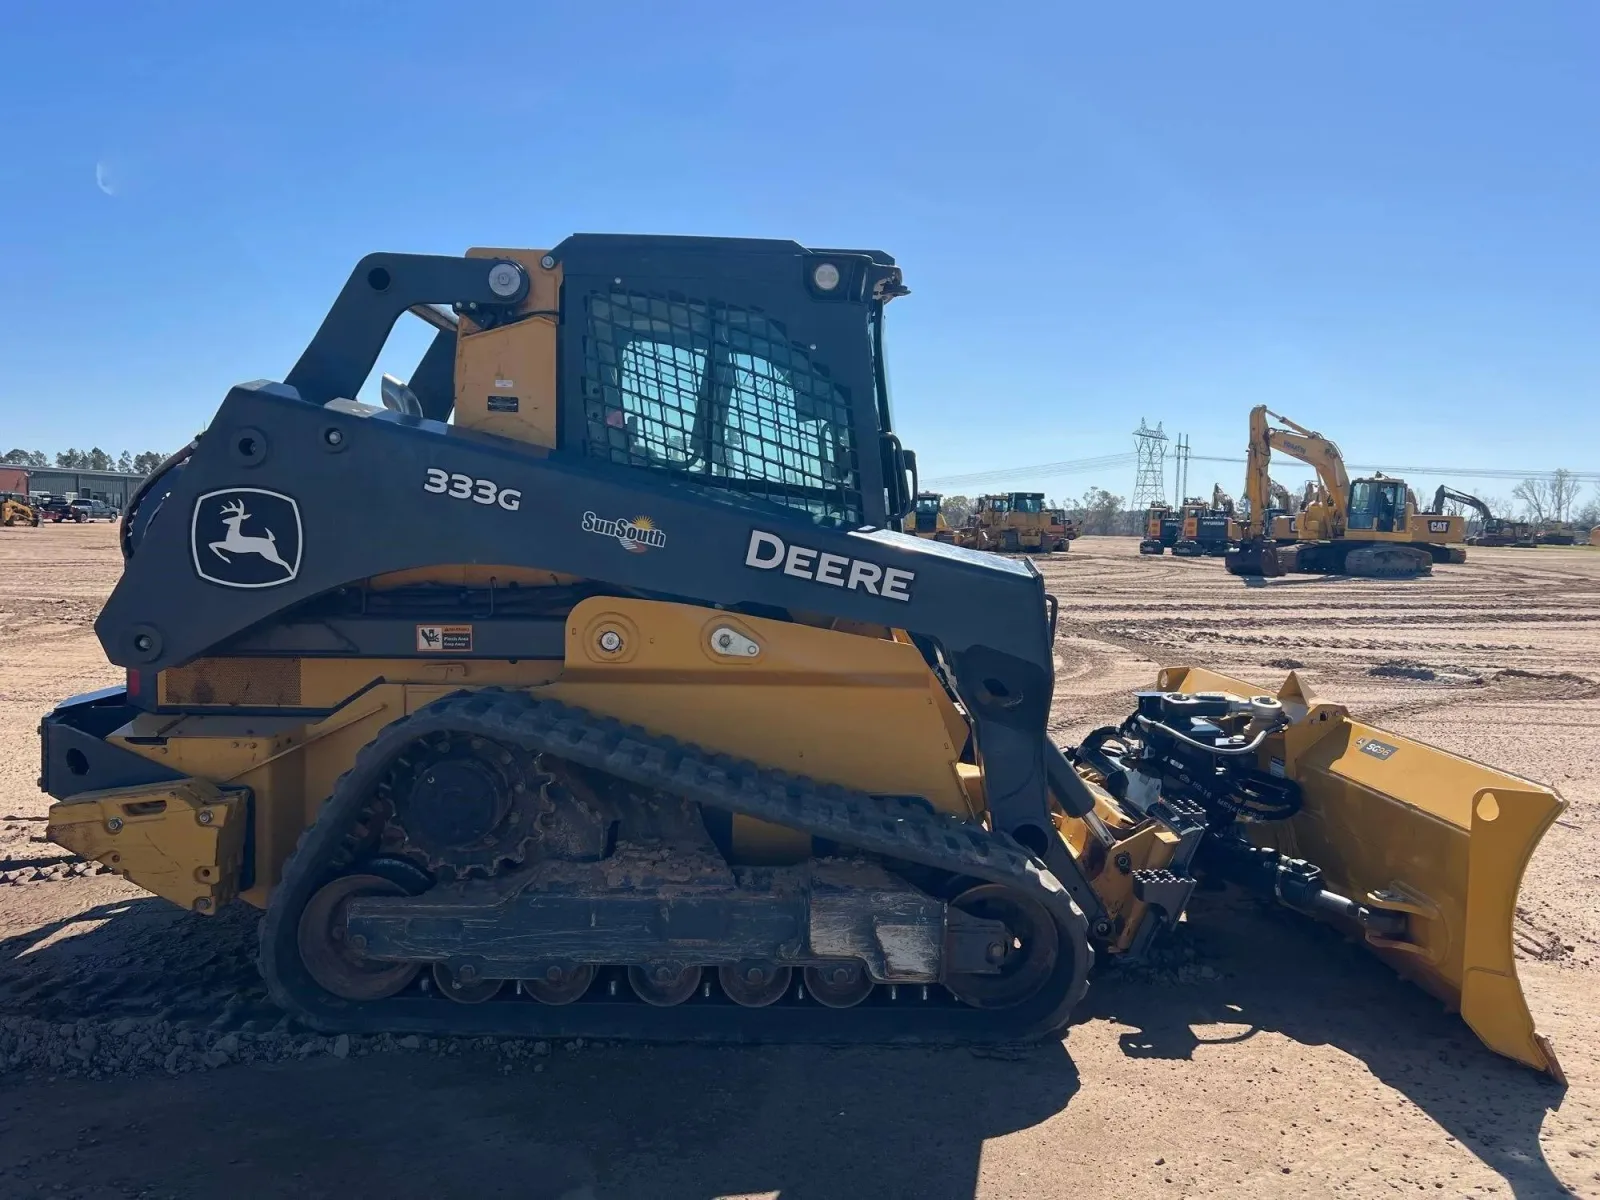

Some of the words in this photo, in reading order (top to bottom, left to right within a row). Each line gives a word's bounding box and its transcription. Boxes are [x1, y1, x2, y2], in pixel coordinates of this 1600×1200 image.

[423, 468, 522, 511] 333G
[582, 511, 666, 548] SunSouth
[1430, 521, 1448, 532] CAT
[745, 529, 916, 602] DEERE
[1366, 743, 1392, 756] SG96
